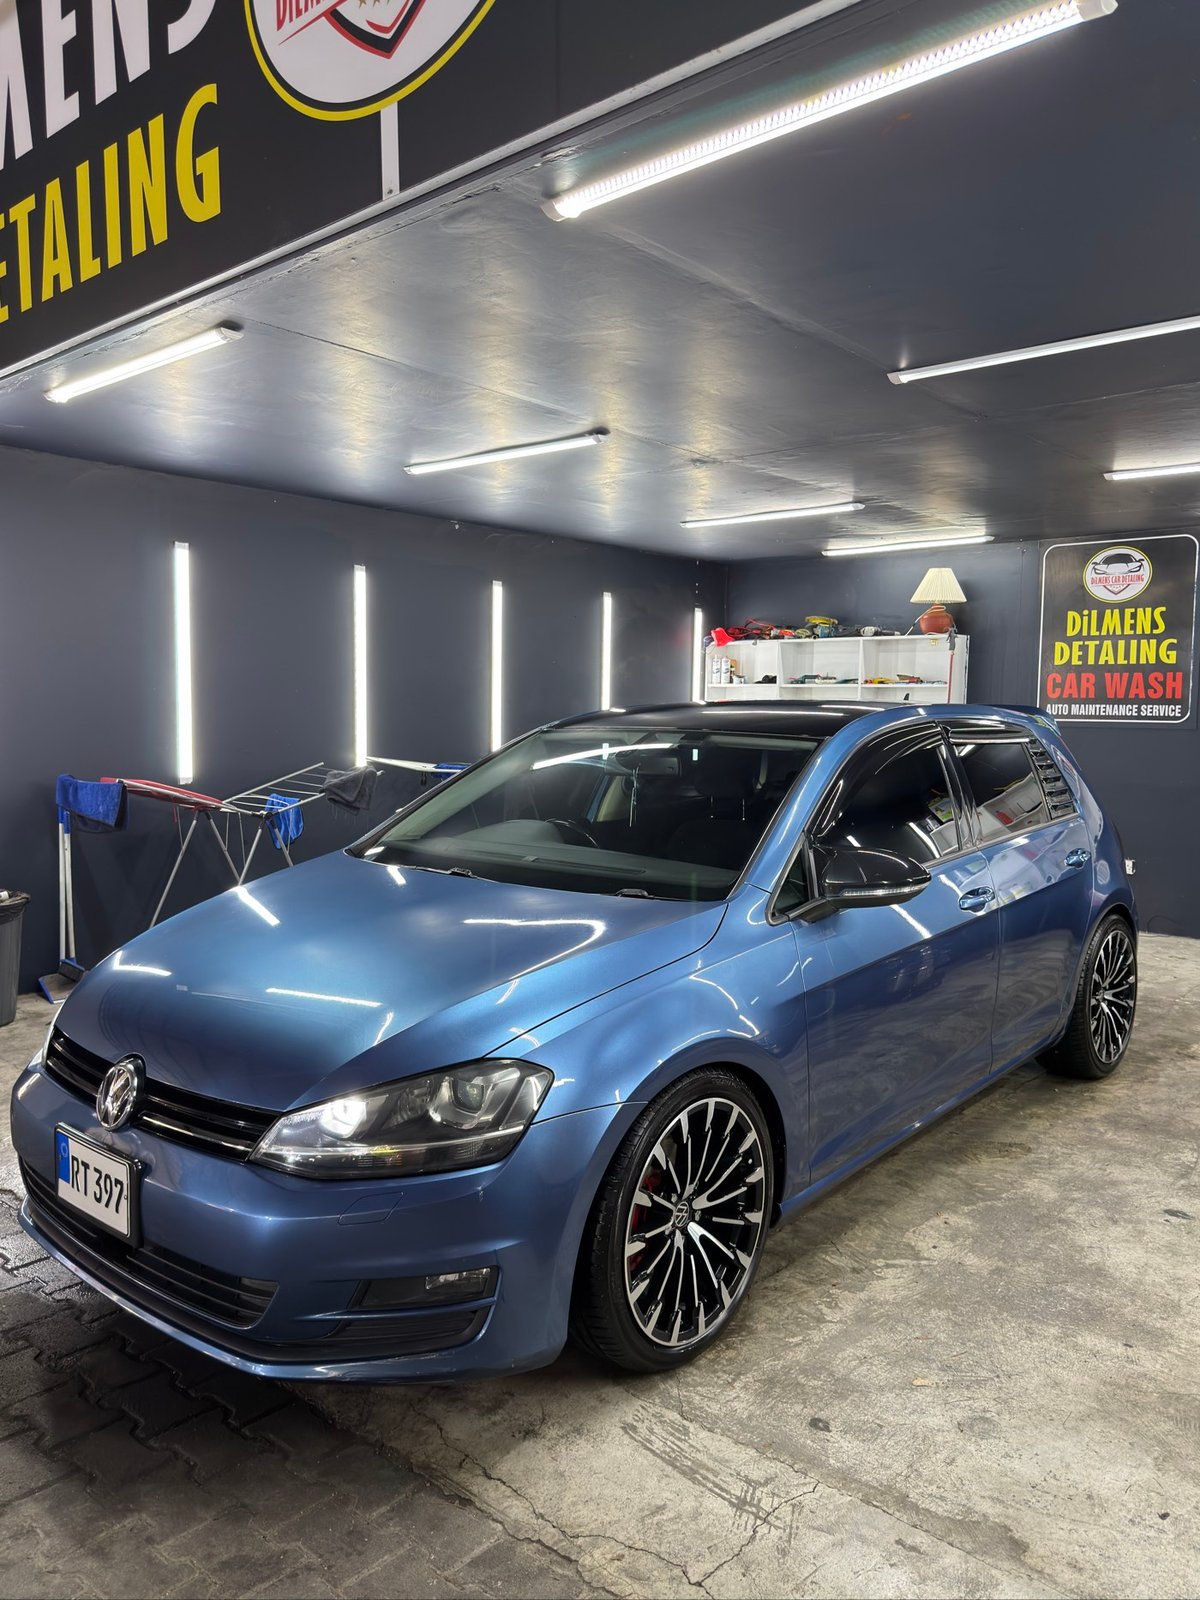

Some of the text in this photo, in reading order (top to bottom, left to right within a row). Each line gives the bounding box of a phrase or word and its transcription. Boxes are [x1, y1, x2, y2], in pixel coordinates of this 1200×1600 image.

[1053, 638, 1178, 665] DETALING
[1046, 672, 1183, 699] CAR WASH
[1046, 704, 1182, 717] AUTO MAINTENANCE SERVICE
[71, 1155, 124, 1214] RT 397
